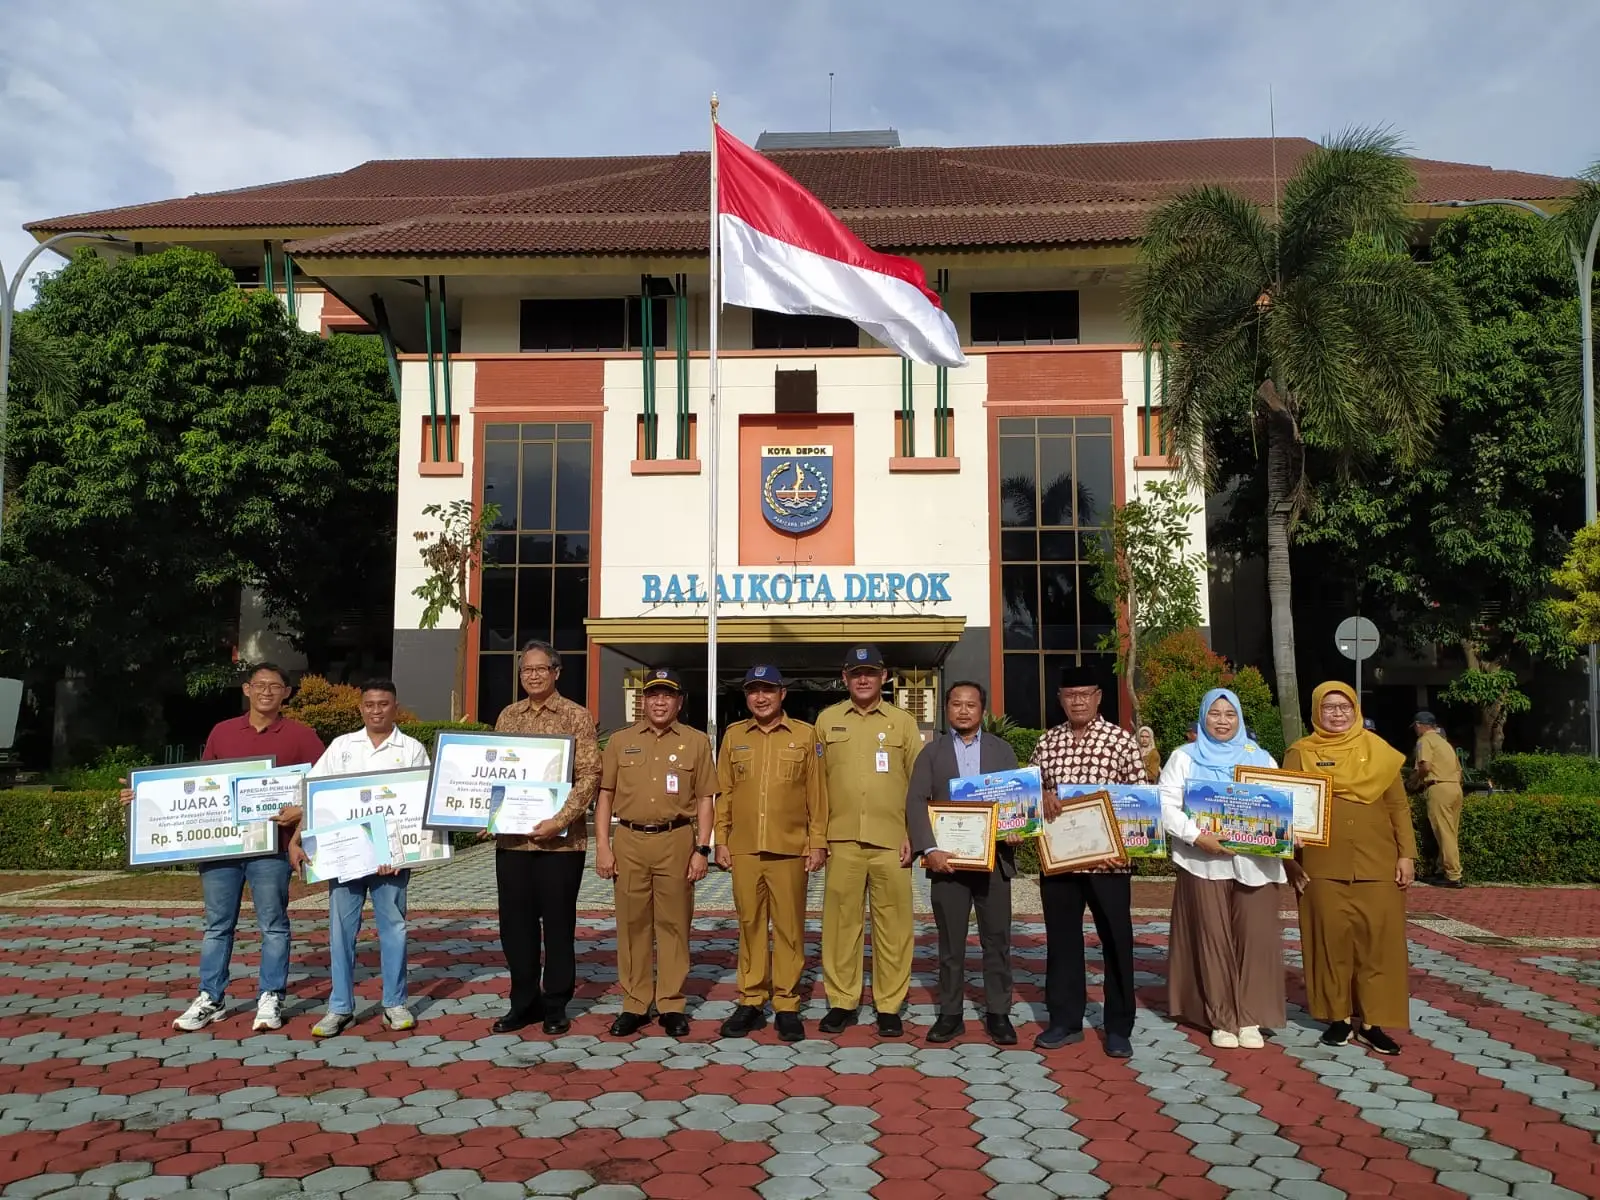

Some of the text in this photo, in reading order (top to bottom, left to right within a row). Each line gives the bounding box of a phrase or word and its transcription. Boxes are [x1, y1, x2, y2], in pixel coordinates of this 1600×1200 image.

[768, 447, 826, 455] KOTA DEPOK
[844, 573, 952, 602] DEPOK
[471, 766, 527, 780] JUARA 1
[170, 796, 218, 812] JUARA
[223, 795, 231, 807] 3
[241, 805, 254, 814] Rp.
[399, 803, 407, 815] 2
[445, 796, 464, 811] Rp.
[151, 826, 248, 847] Rp. 5.000.000,-
